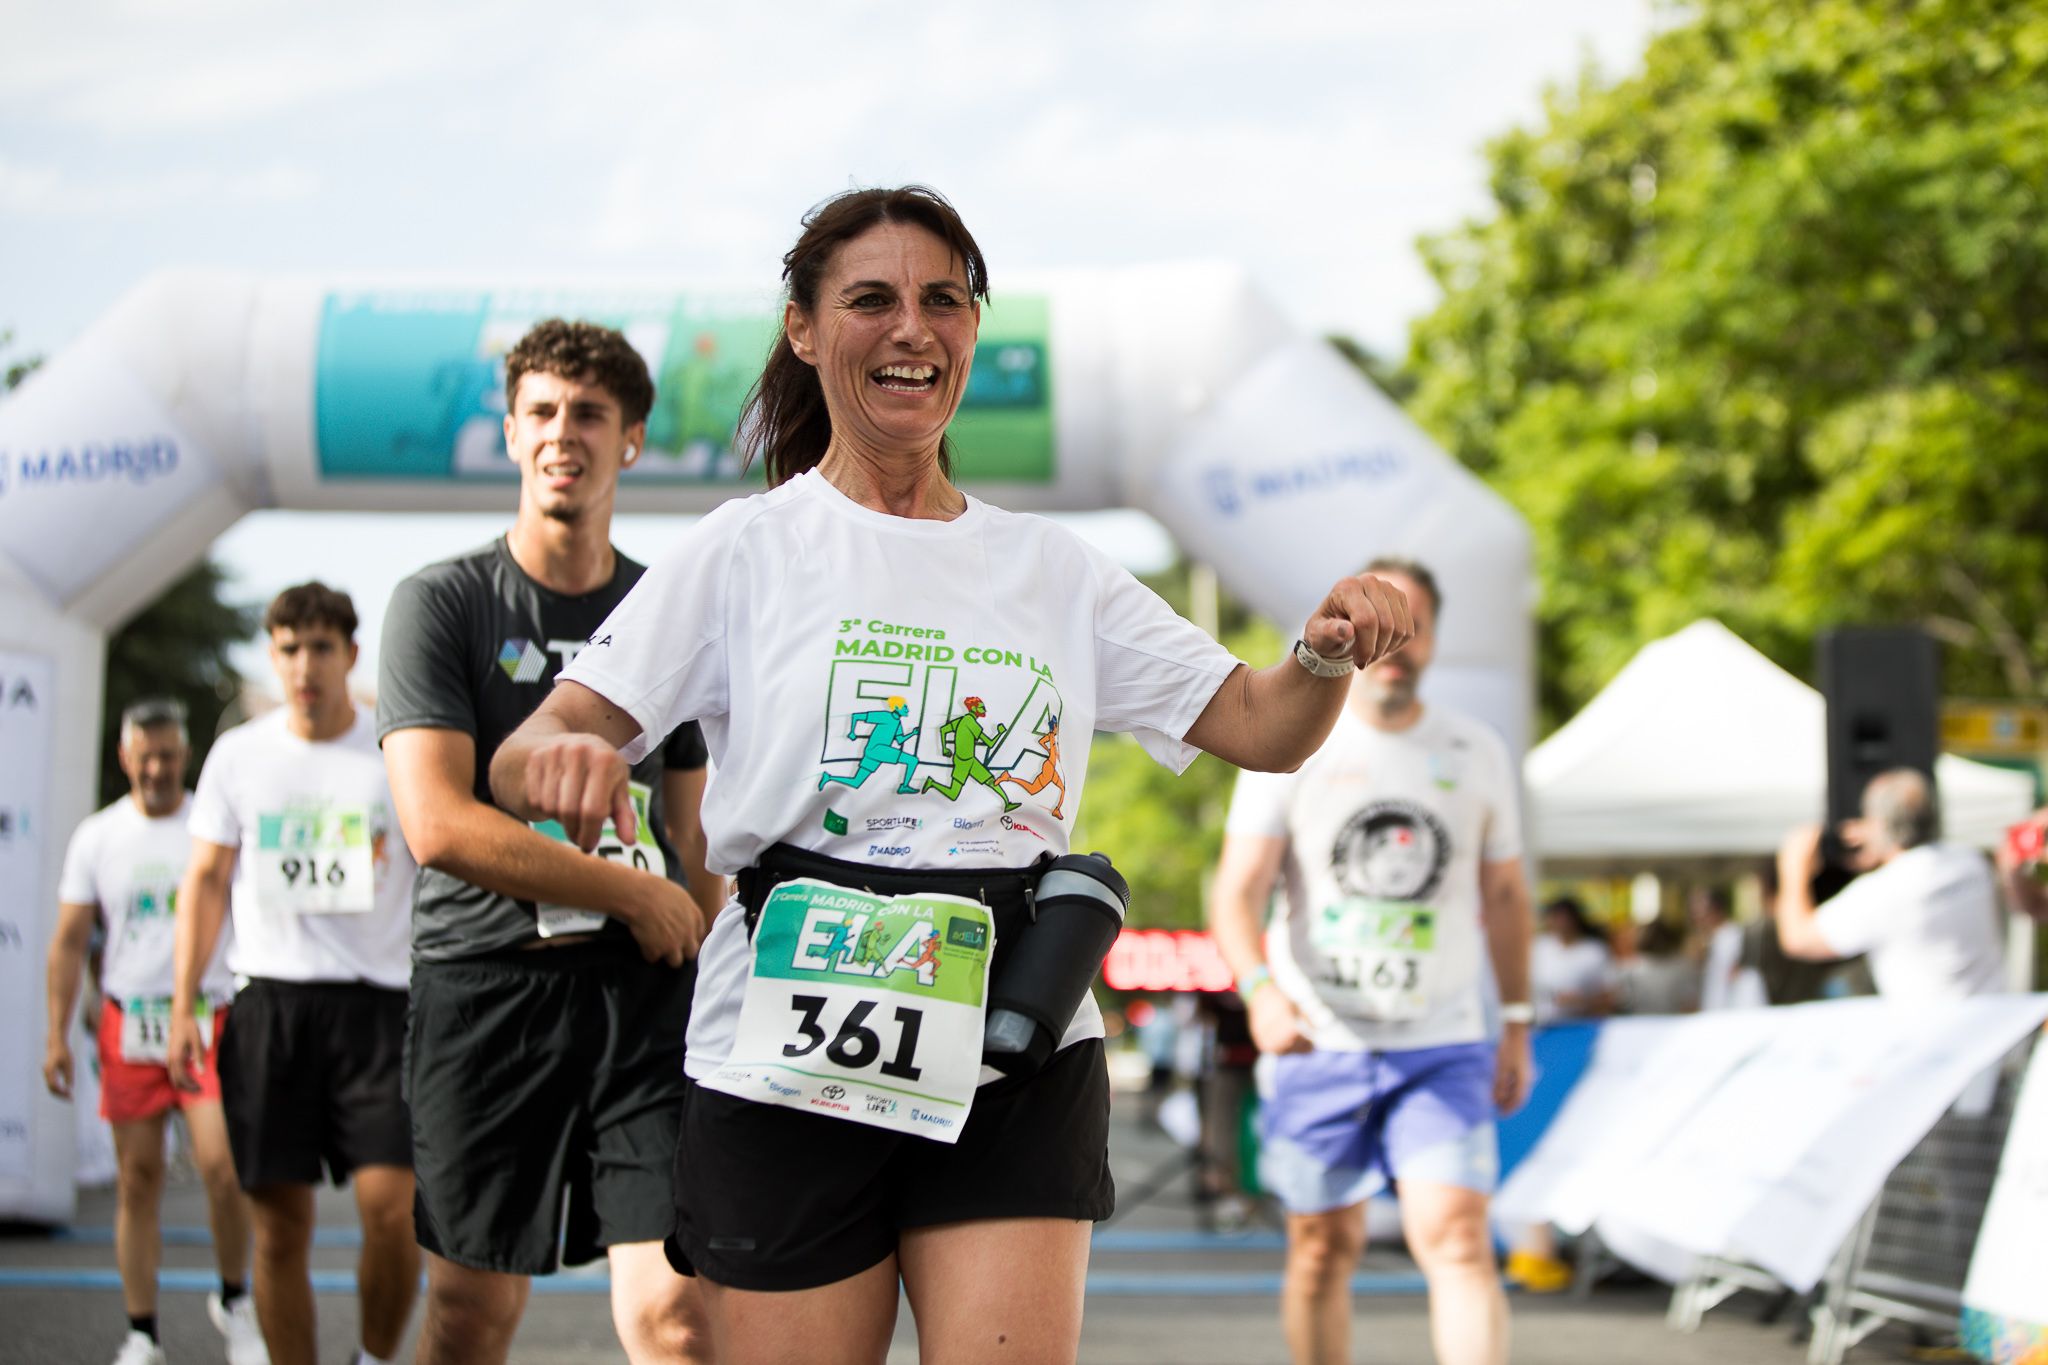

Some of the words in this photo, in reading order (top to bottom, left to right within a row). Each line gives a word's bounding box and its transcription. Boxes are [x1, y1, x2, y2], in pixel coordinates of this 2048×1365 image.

[838, 618, 862, 633] 3ª
[867, 619, 946, 640] Carrera
[835, 639, 955, 663] MADRID
[963, 646, 1023, 668] CON
[1029, 656, 1054, 682] LA
[820, 659, 1063, 771] ELA
[877, 846, 911, 856] MADRID
[281, 858, 346, 888] 916
[810, 893, 875, 913] MADRID
[877, 903, 909, 917] CON
[913, 903, 934, 919] LA
[791, 906, 937, 987] ELA
[782, 994, 924, 1082] 361
[919, 1111, 954, 1128] MADRID
